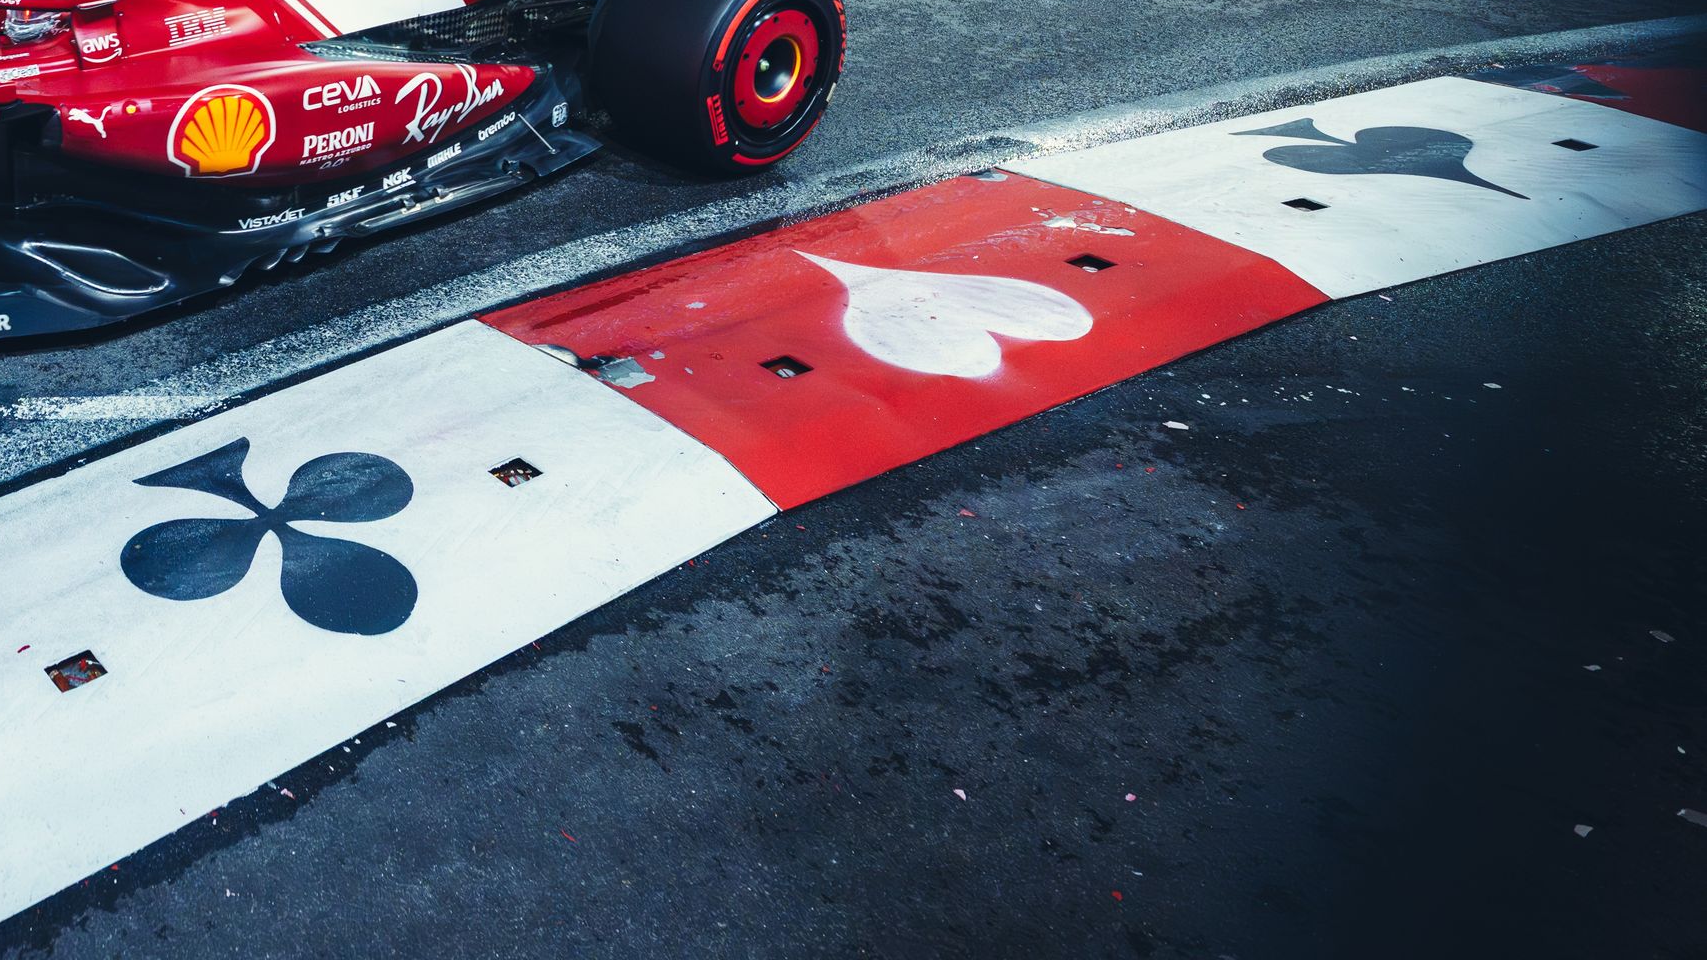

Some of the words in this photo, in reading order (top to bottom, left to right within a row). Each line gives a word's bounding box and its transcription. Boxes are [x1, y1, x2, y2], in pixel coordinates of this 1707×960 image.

[164, 7, 232, 47] IBM
[82, 32, 121, 56] aws
[338, 97, 381, 114] LOGISTICS
[477, 111, 516, 141] brembo
[302, 122, 376, 158] PERONI
[299, 152, 334, 166] NASTRO
[335, 143, 372, 158] AZZURRO
[427, 142, 463, 169] MAHLE
[382, 167, 413, 190] NGK
[326, 185, 365, 208] SKF
[238, 208, 306, 230] VISTAJET
